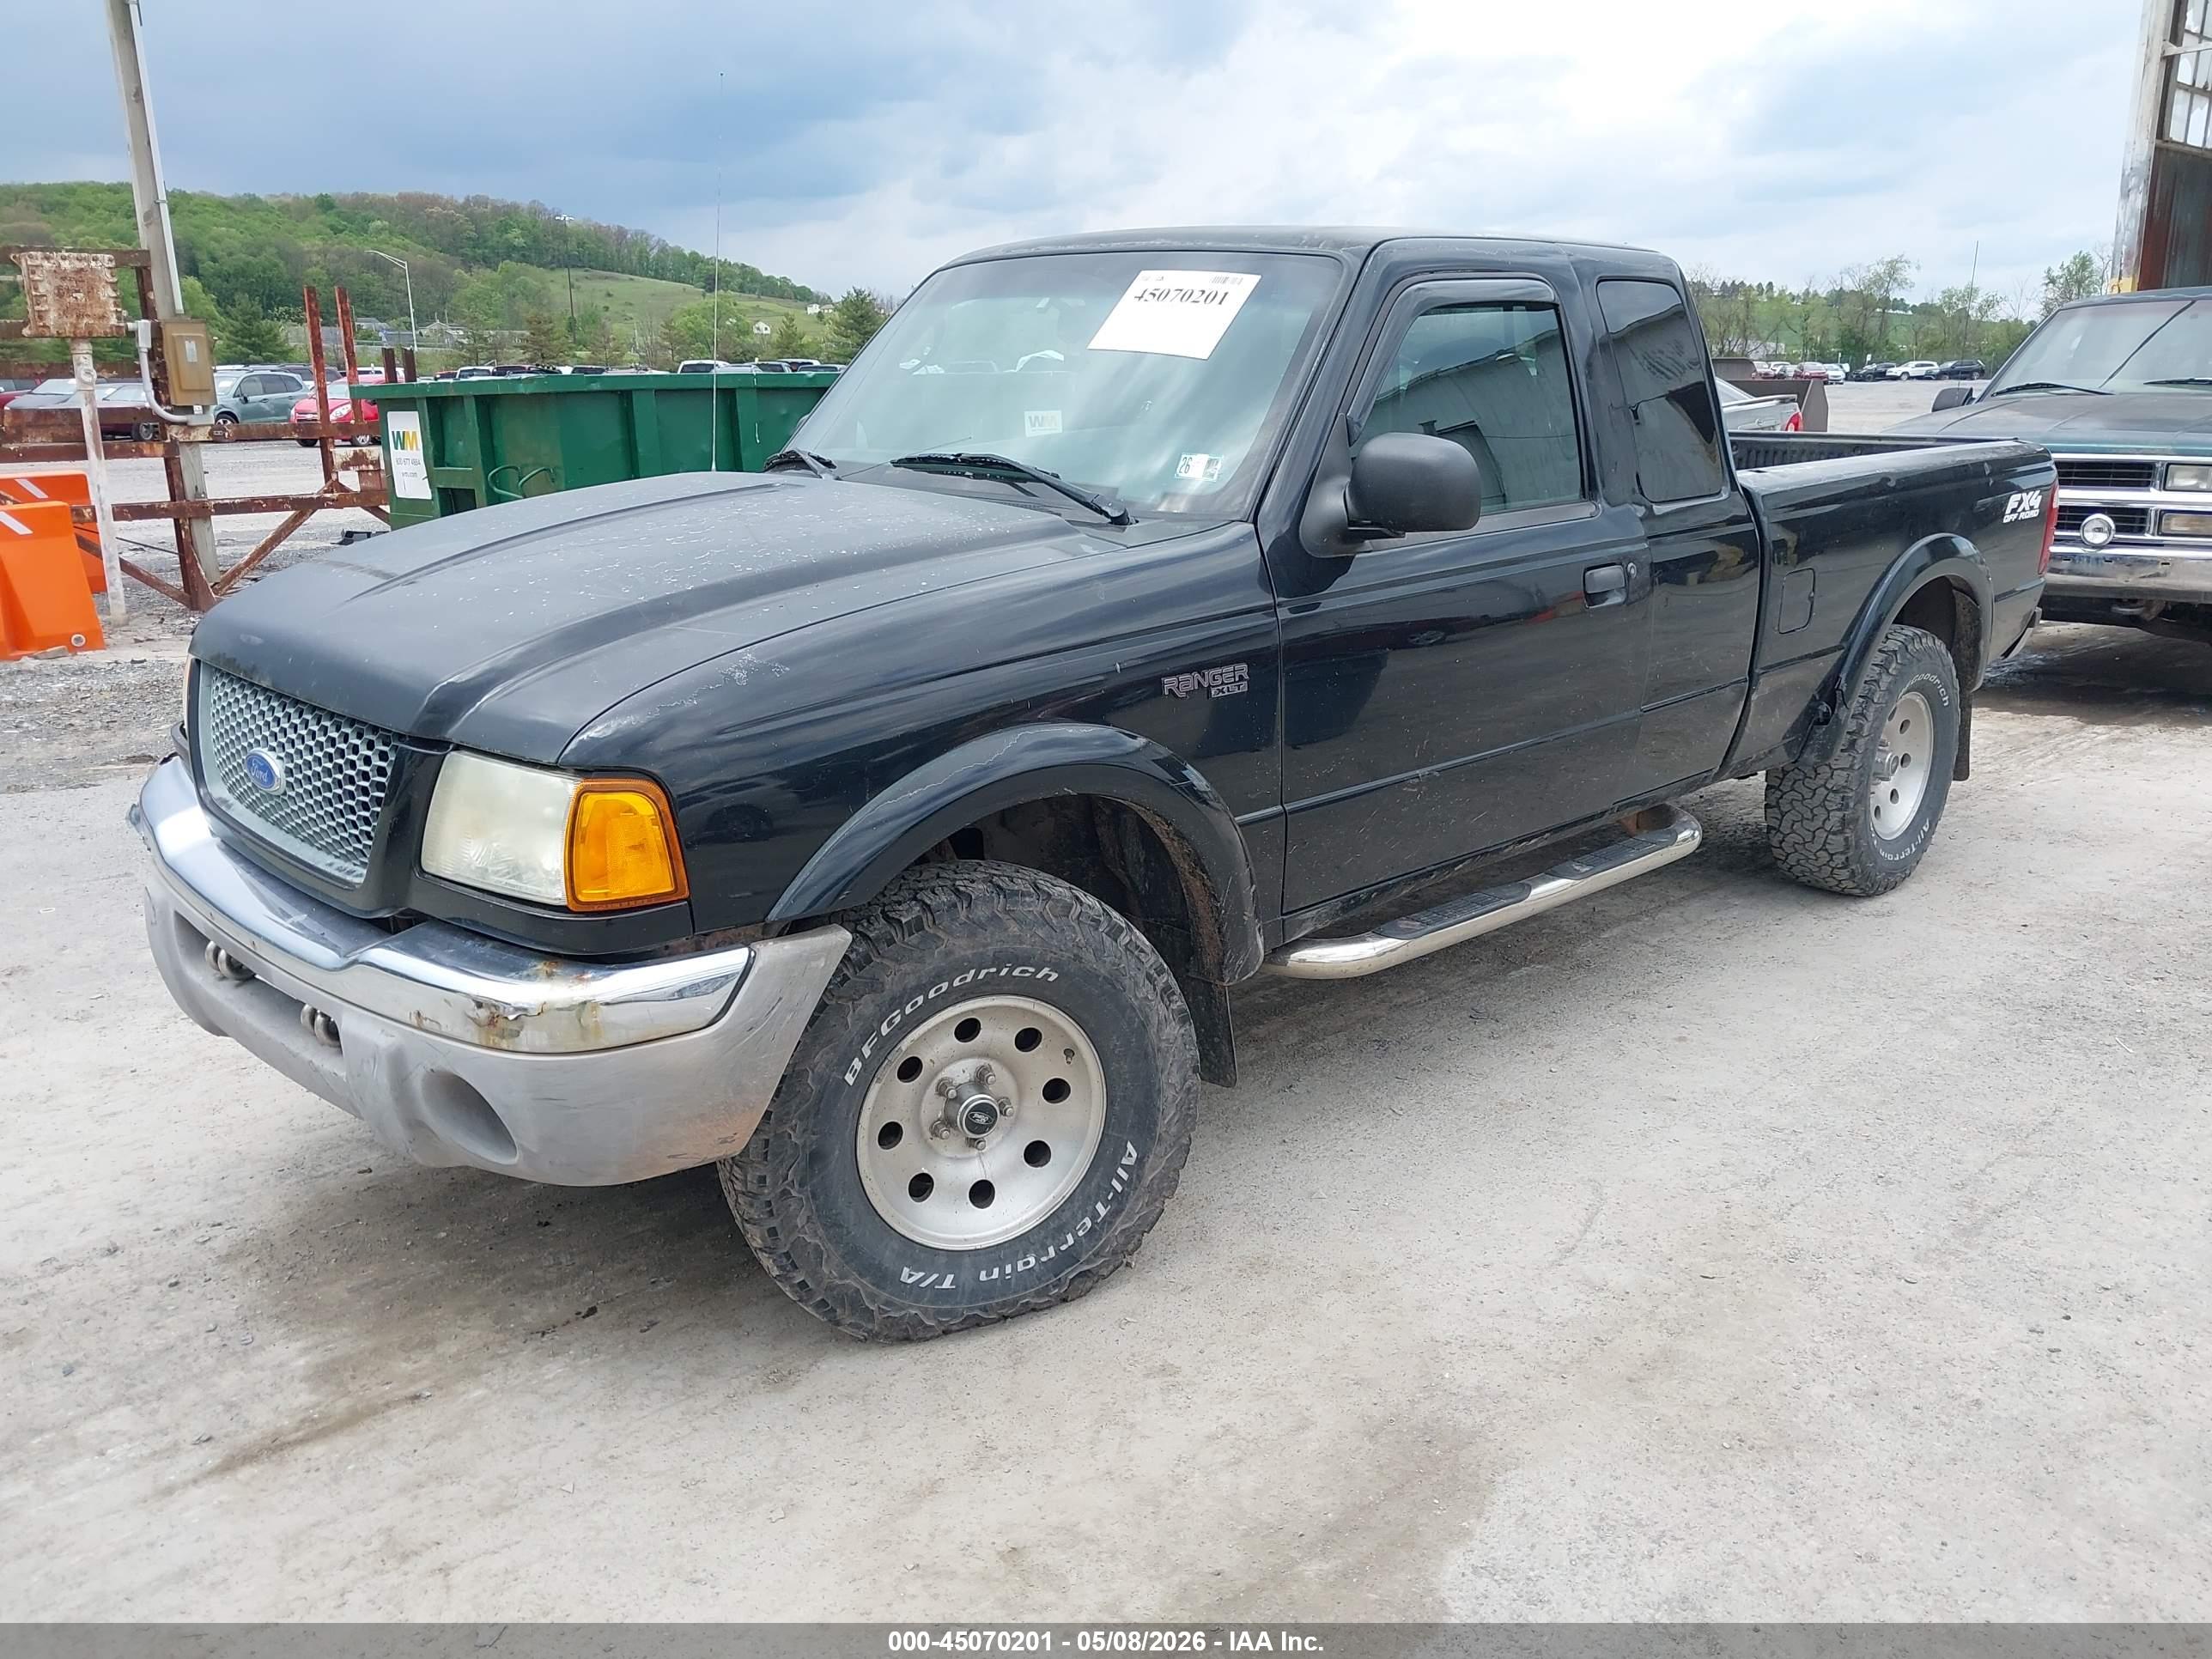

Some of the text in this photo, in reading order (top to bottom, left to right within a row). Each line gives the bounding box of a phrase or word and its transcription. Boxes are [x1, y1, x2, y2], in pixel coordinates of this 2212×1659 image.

[1133, 289, 1229, 305] 45070201
[392, 430, 420, 451] WM
[1179, 457, 1193, 473] 26
[2004, 489, 2042, 515] FX4
[2002, 514, 2018, 524] OFF
[1161, 663, 1249, 697] RANGER
[1211, 683, 1247, 696] XLT
[252, 758, 269, 784] Ford
[844, 963, 1059, 1086] BFGoodrich
[900, 1140, 1138, 1289] All-Terrain T/A
